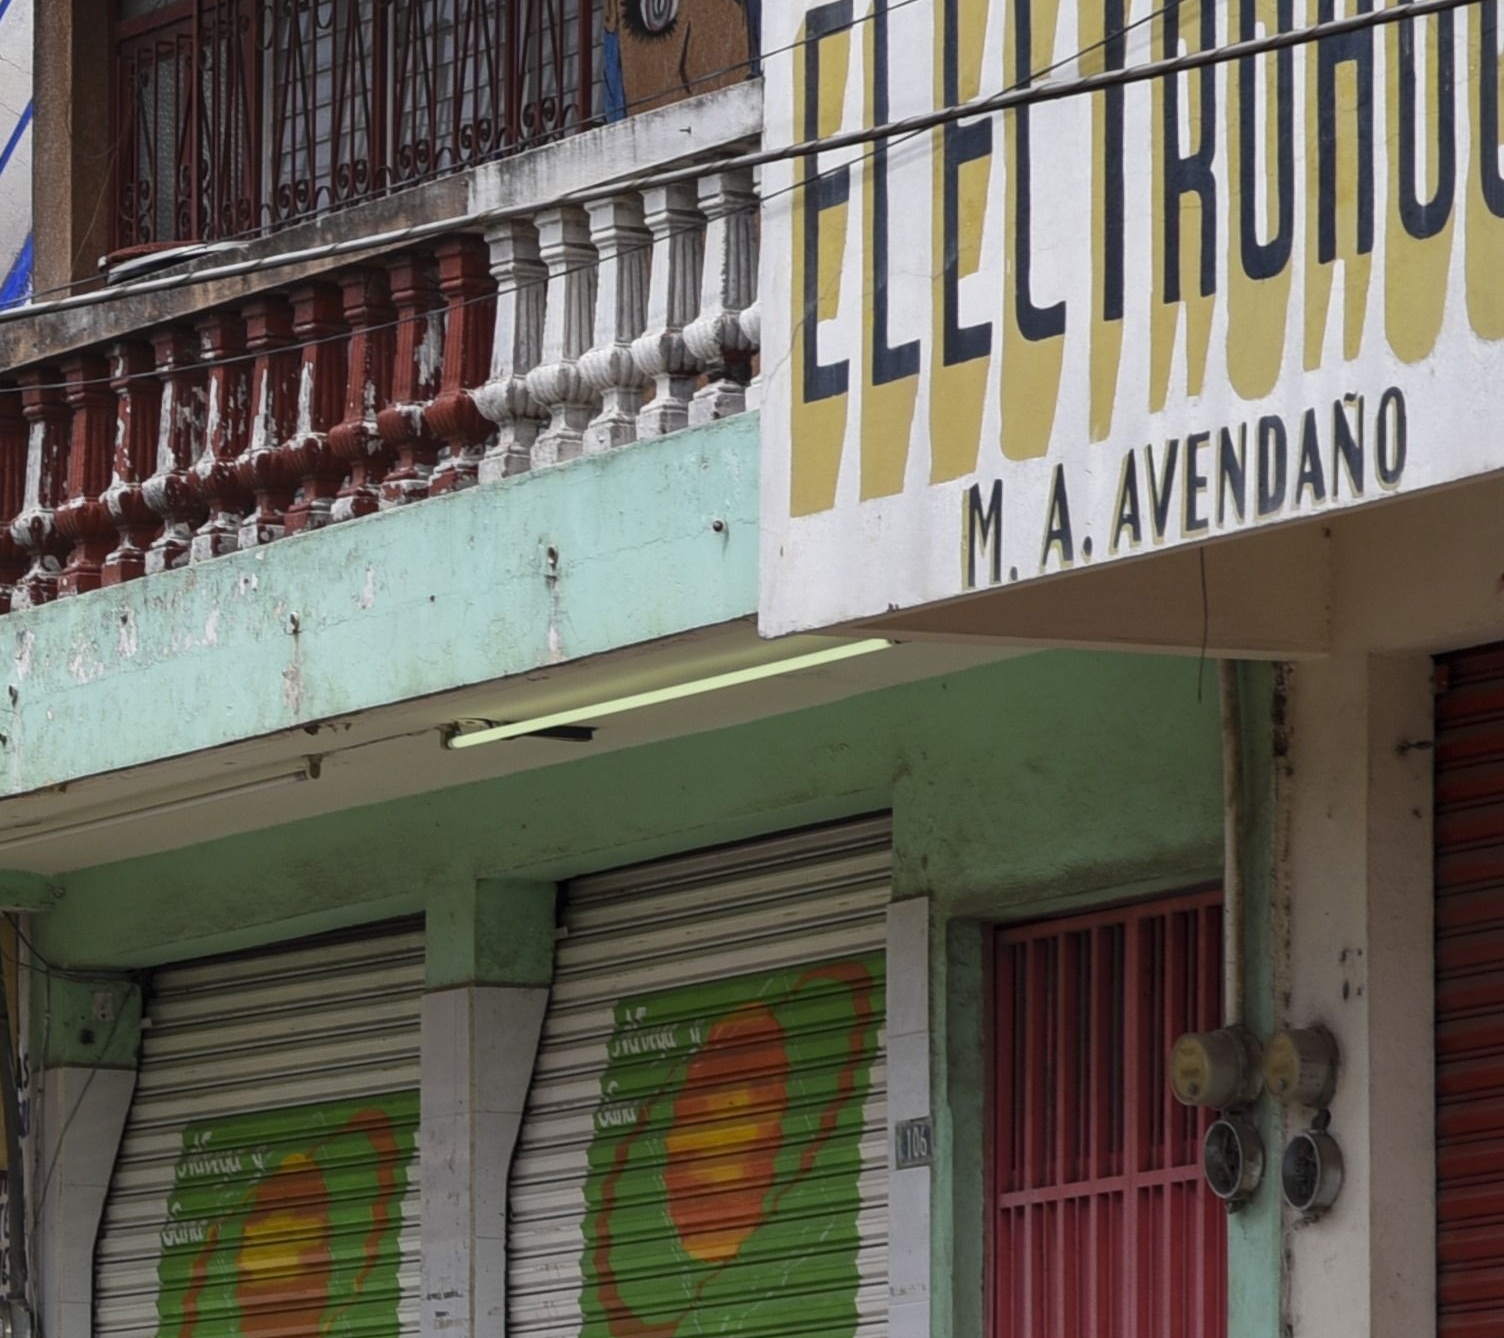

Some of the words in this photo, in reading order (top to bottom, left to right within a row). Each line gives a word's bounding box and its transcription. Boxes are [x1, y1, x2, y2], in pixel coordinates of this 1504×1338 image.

[963, 478, 1019, 591] M.
[1041, 462, 1093, 572] A.
[1109, 386, 1407, 556] AVENDAÑO
[906, 1126, 928, 1160] 106
